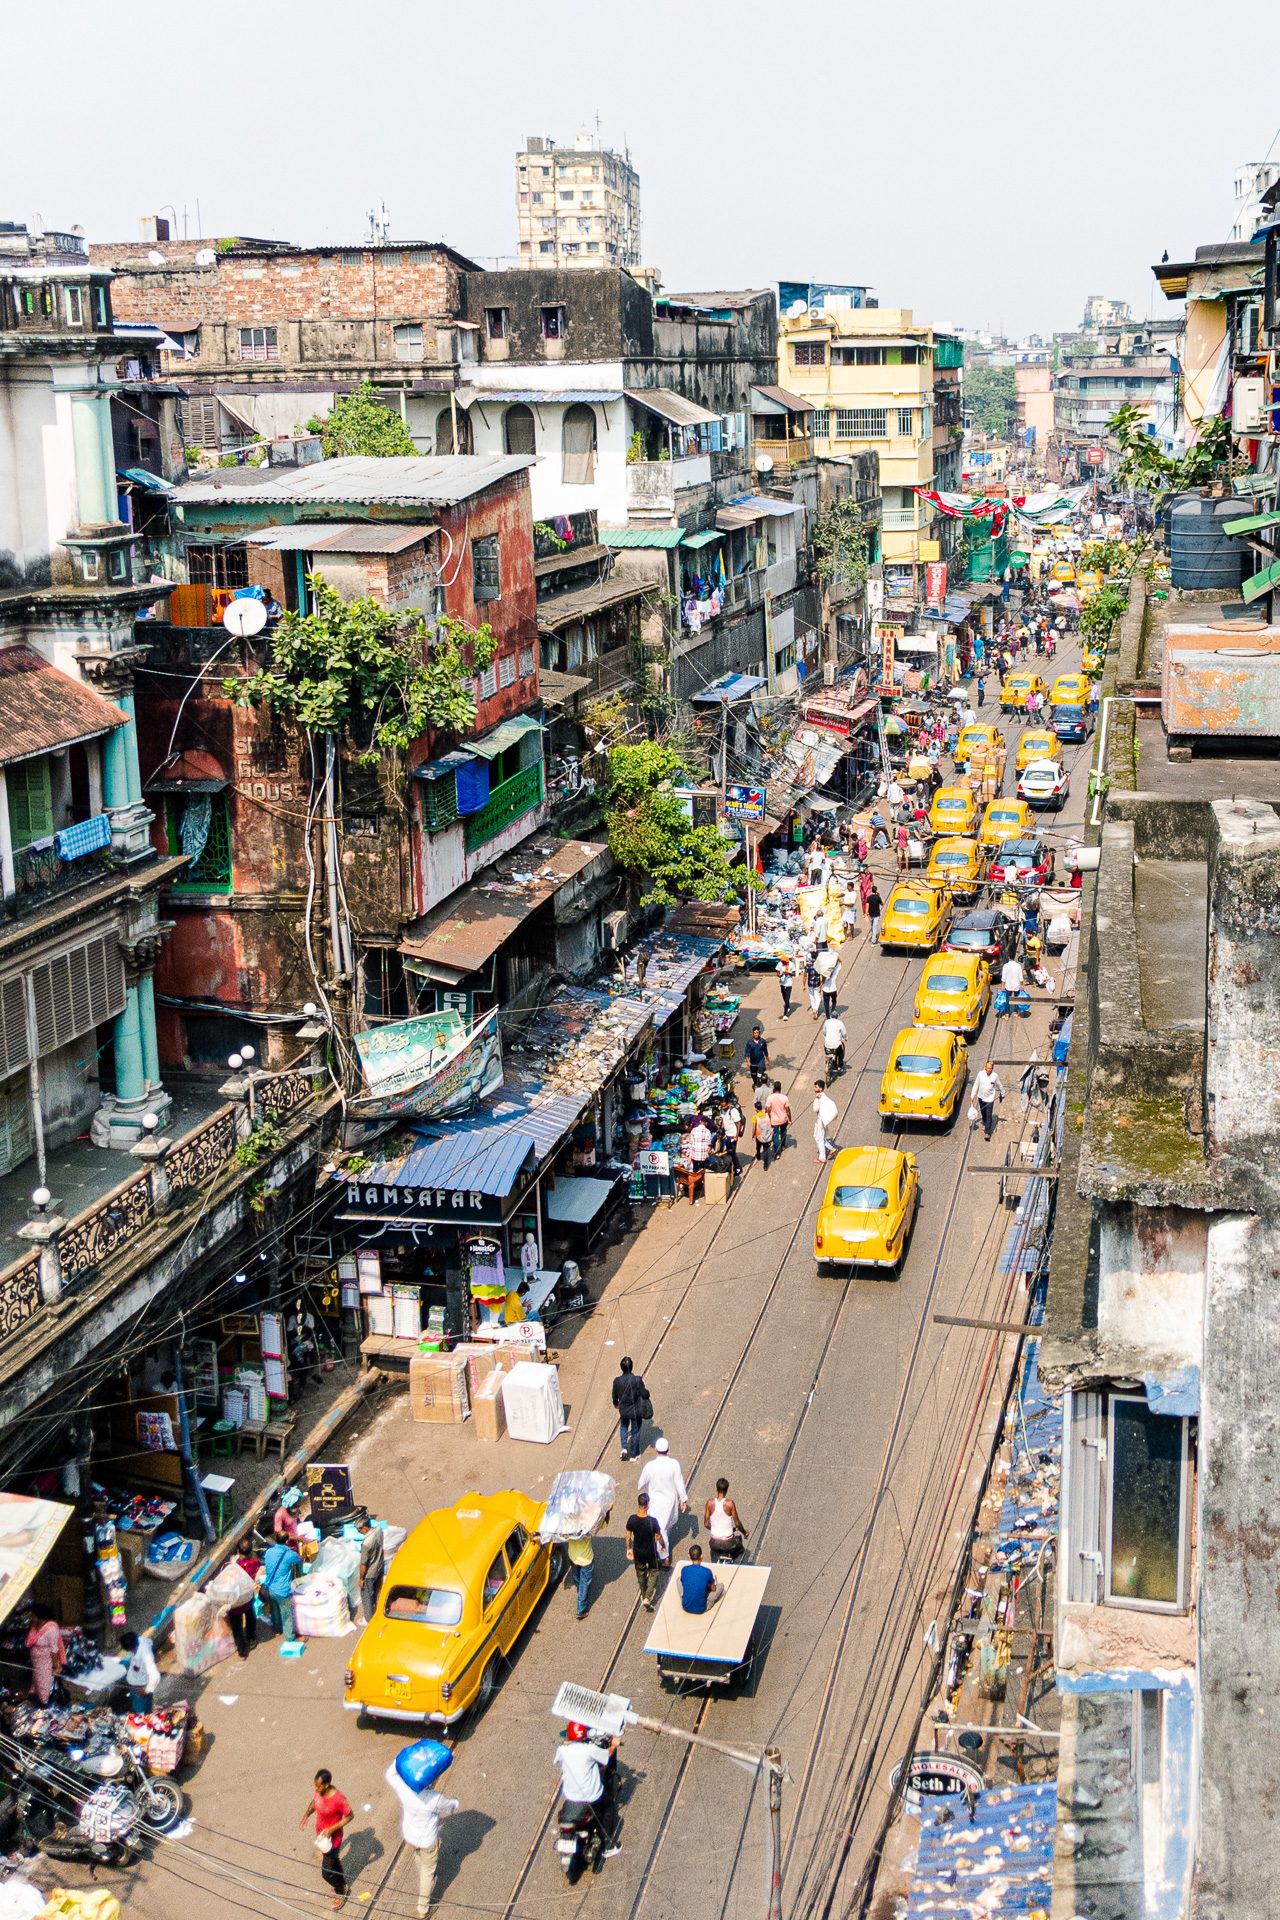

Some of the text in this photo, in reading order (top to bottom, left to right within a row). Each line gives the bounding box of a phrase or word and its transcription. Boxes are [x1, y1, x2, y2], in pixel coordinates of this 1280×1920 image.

[931, 567, 942, 597] GUEST
[238, 758, 300, 778] GUEST
[239, 782, 308, 802] HOUSE
[347, 1186, 483, 1211] HAMSAFAR
[912, 1763, 969, 1779] HOLESALE
[912, 1776, 943, 1791] Seth
[947, 1779, 961, 1792] Ji
